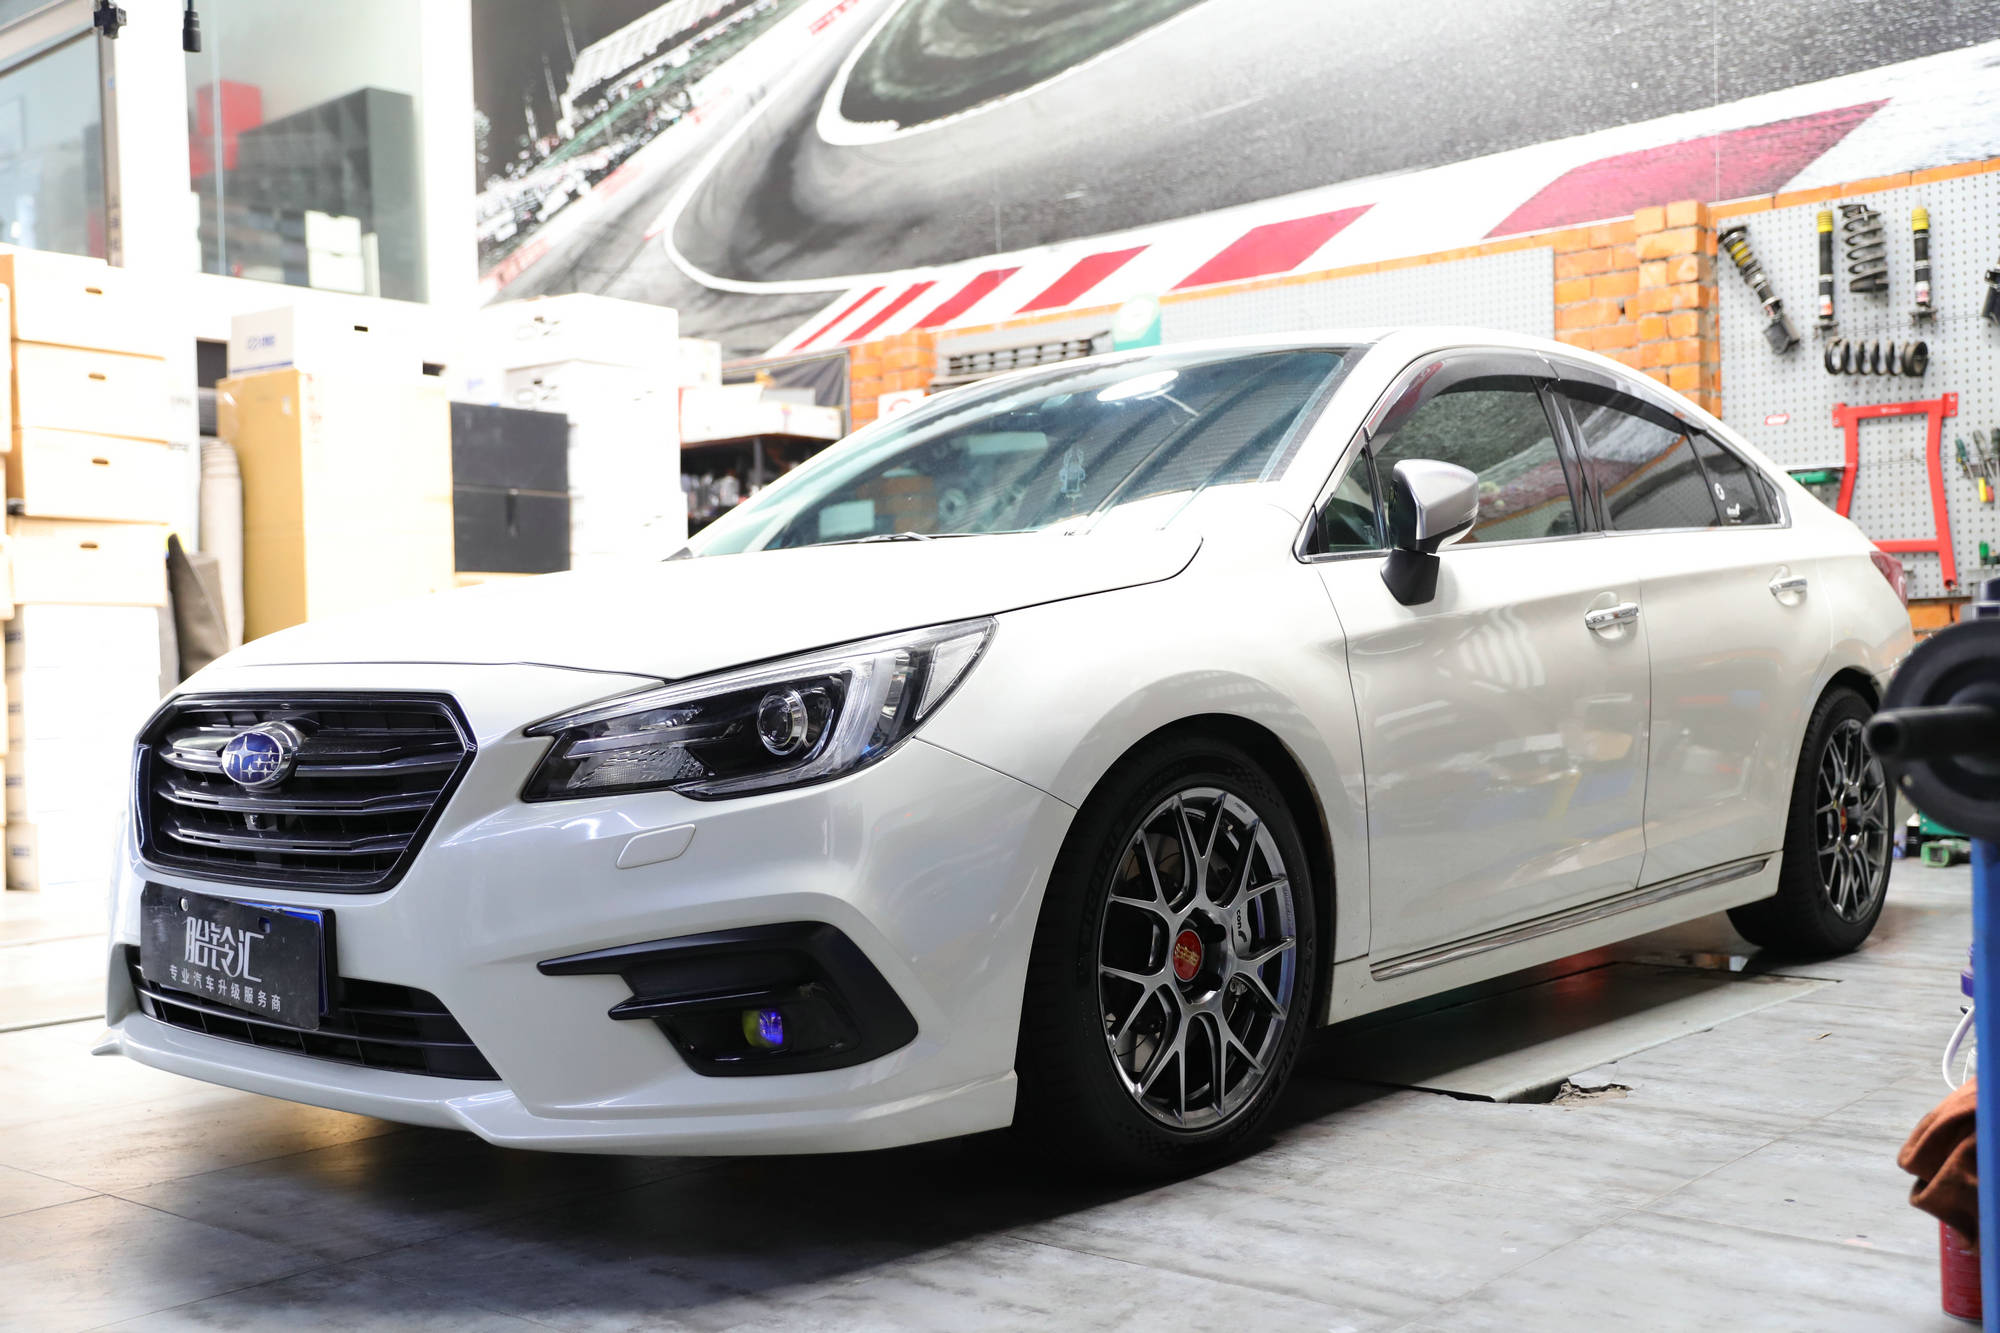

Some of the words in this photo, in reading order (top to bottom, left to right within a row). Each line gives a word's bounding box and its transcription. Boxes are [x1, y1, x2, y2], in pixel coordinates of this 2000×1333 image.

[184, 916, 264, 982] 胎铃汇
[169, 964, 281, 1012] 专业汽车升级服务商
